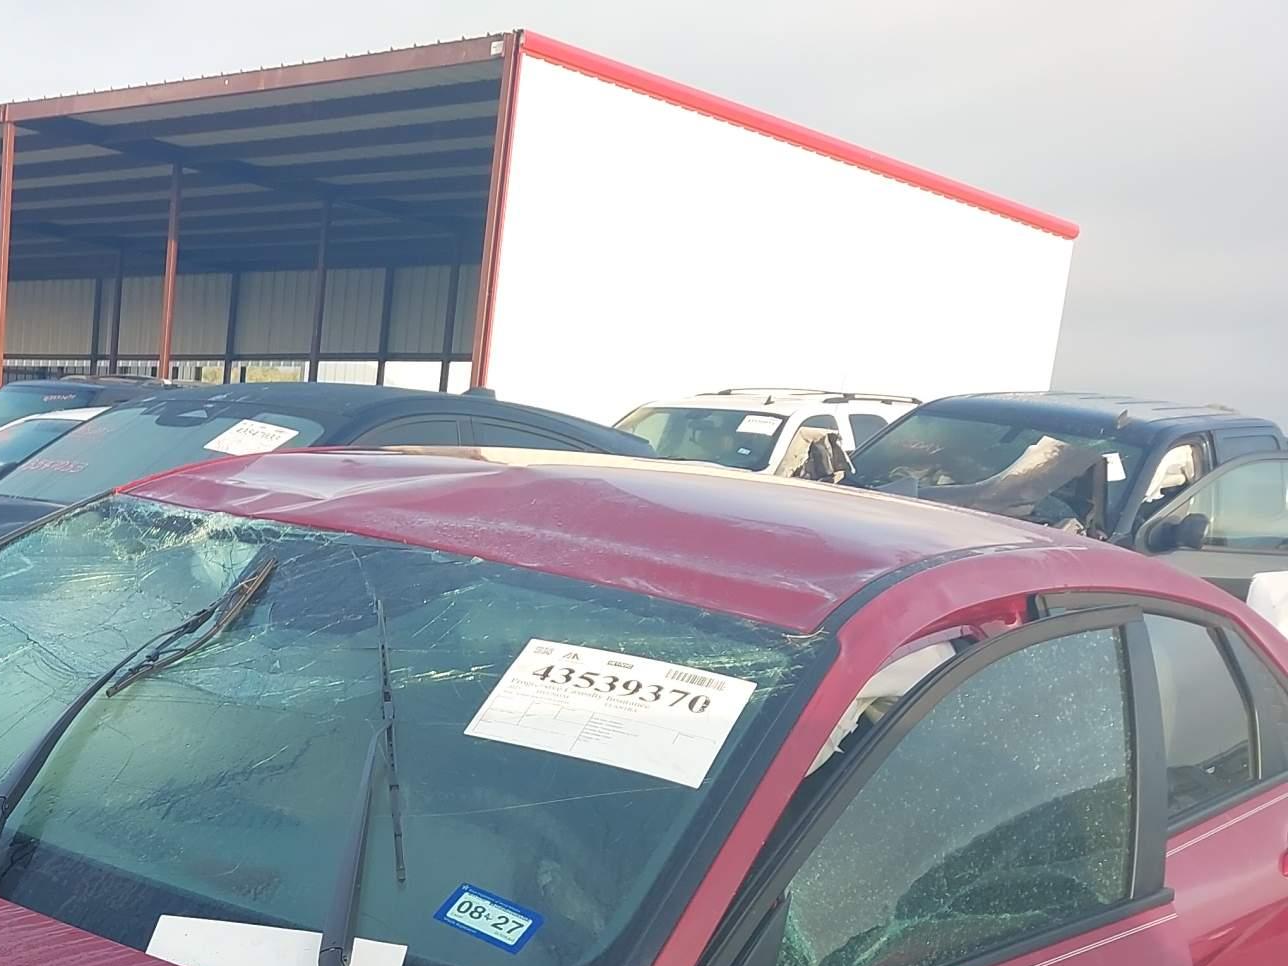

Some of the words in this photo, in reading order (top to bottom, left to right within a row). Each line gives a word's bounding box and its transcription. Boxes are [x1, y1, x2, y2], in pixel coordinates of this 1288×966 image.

[532, 664, 711, 714] 43539370
[456, 900, 486, 921] 08
[491, 915, 524, 935] 27
